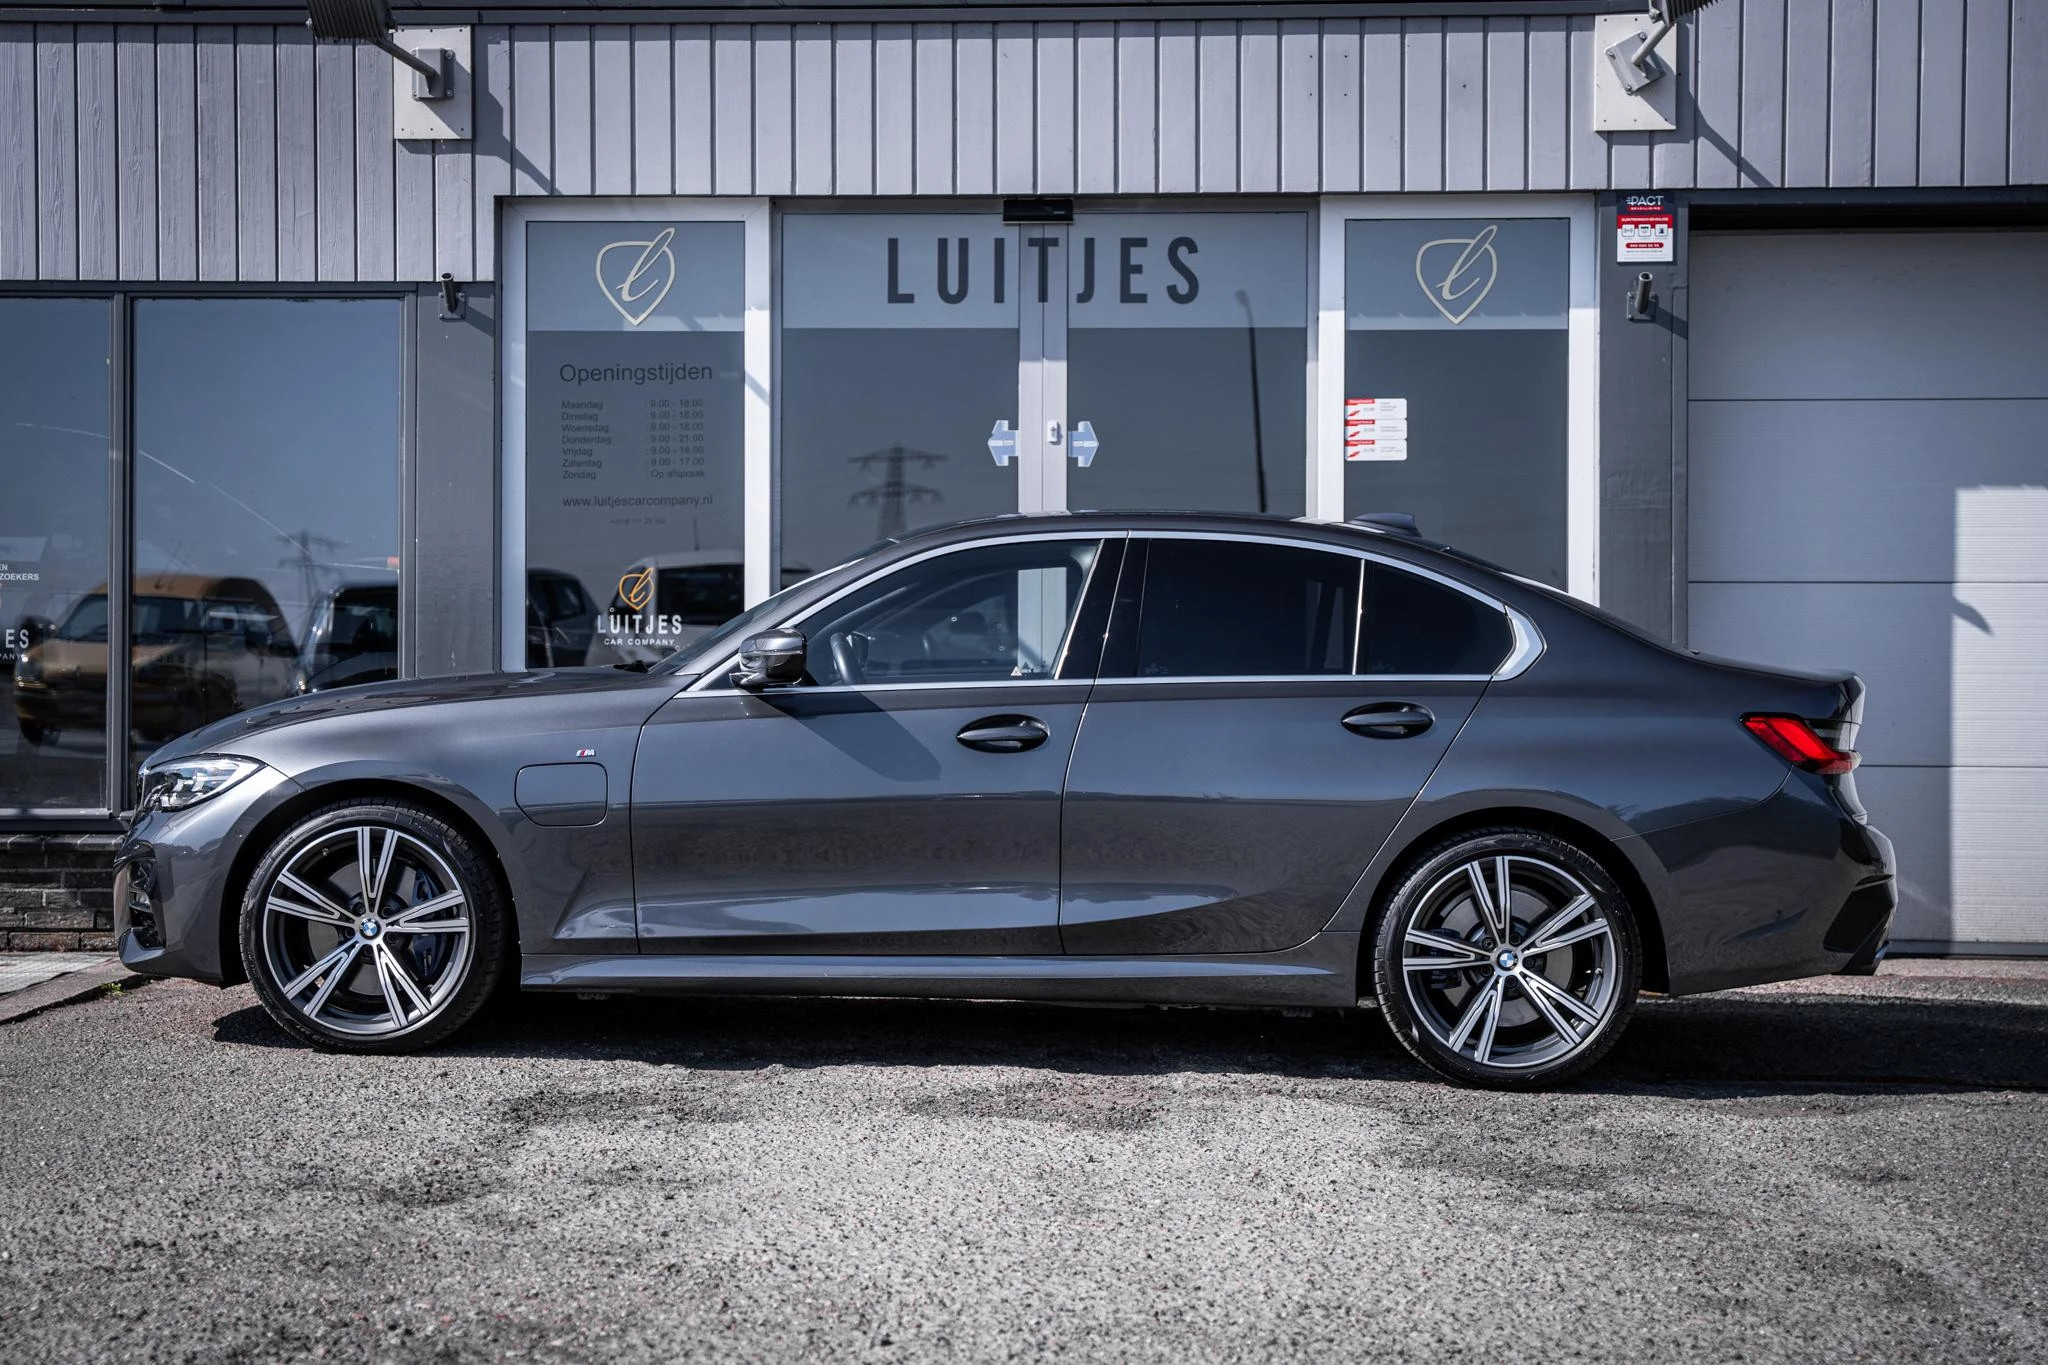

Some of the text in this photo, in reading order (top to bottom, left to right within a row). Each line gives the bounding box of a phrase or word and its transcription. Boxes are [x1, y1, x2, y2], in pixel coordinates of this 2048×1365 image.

[1628, 195, 1664, 206] PACT
[887, 236, 1199, 304] LUITJES
[559, 363, 713, 386] Openingstijden
[562, 470, 596, 480] Zondag
[562, 495, 713, 508] www.luitjescarcompany.nl
[597, 614, 682, 635] LUITJES
[604, 638, 675, 646] CAR COMPANY
